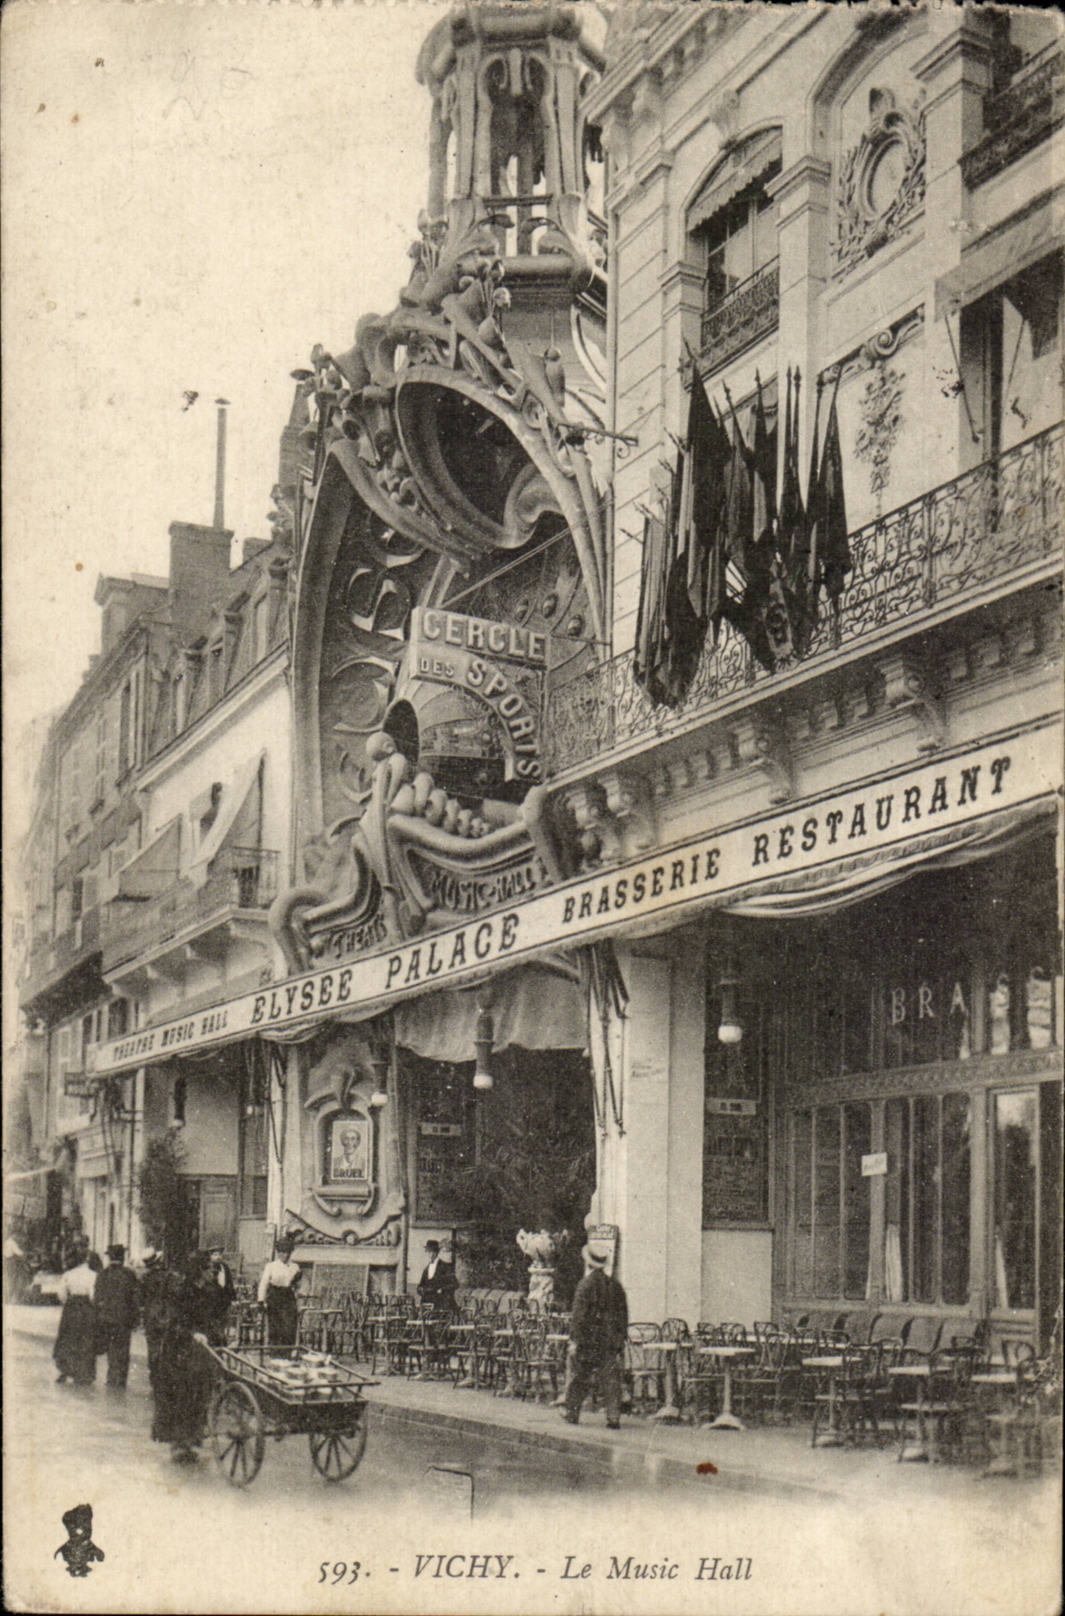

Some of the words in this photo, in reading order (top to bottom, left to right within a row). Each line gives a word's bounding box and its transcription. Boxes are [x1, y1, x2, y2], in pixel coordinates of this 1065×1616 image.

[423, 611, 546, 662] CERCLE
[420, 656, 454, 677] DES
[466, 660, 542, 778] SPORTS
[161, 1021, 195, 1047] MUSIC
[200, 1010, 228, 1036] HALL
[250, 969, 353, 1025] ELYSEE
[384, 912, 519, 990] PALACE
[561, 848, 721, 925] BRASSERIE
[751, 756, 1012, 867] RESTAURANT
